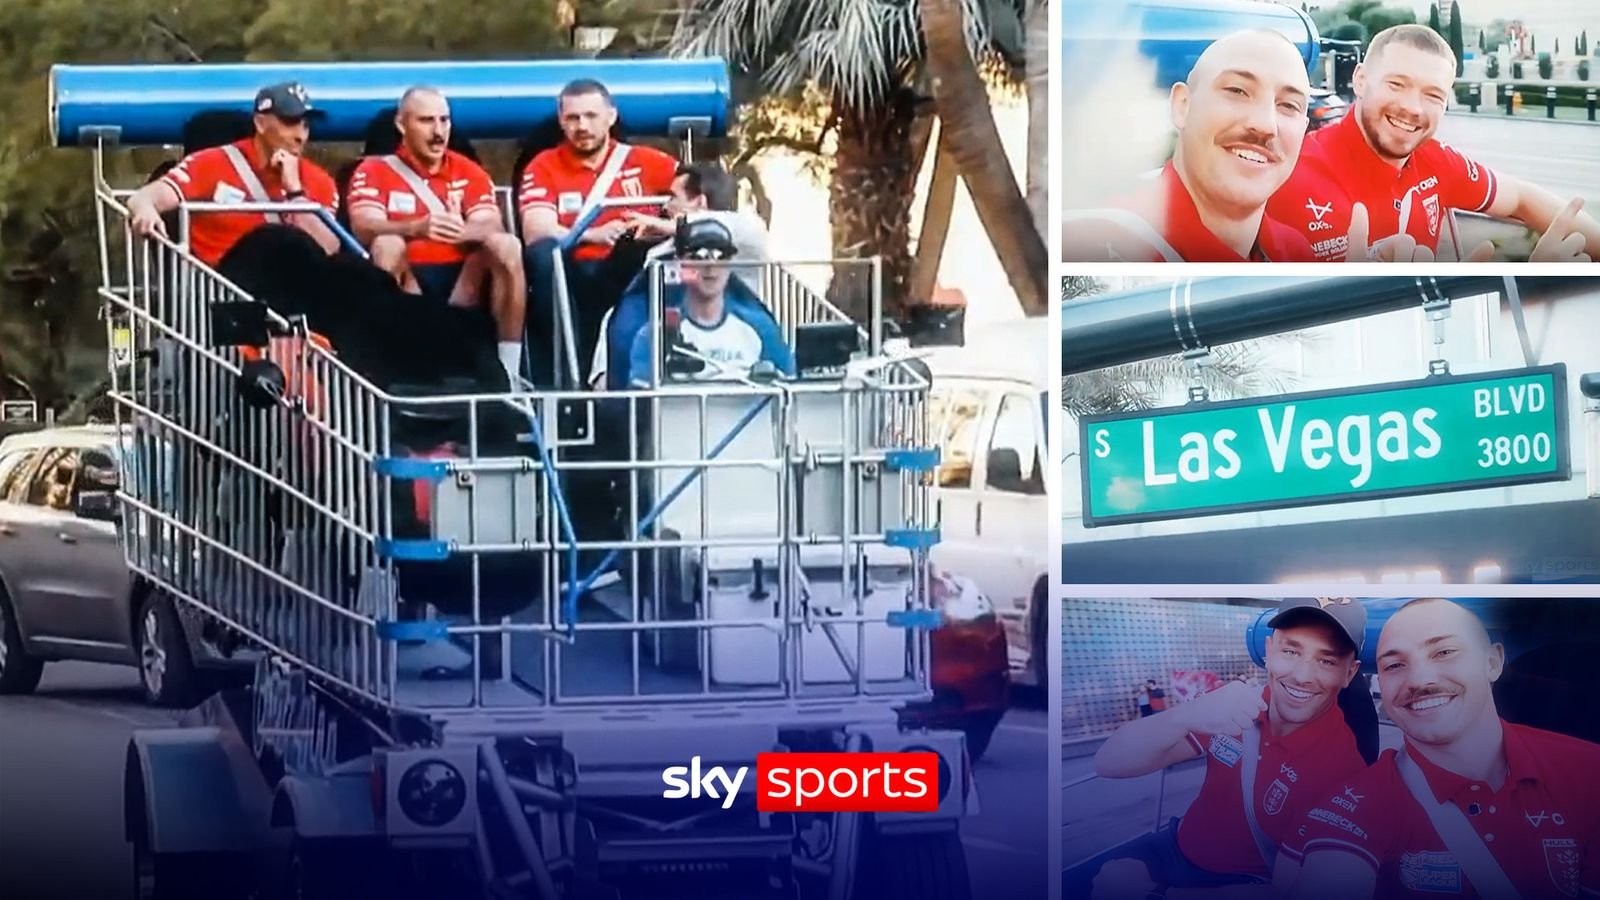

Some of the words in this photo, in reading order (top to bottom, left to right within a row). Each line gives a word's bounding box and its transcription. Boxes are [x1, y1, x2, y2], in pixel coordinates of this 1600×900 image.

[1095, 429, 1111, 458] S
[1143, 420, 1242, 486] Las
[1257, 405, 1442, 488] Vegas
[1474, 383, 1545, 418] BLVD
[1477, 432, 1551, 468] 3800
